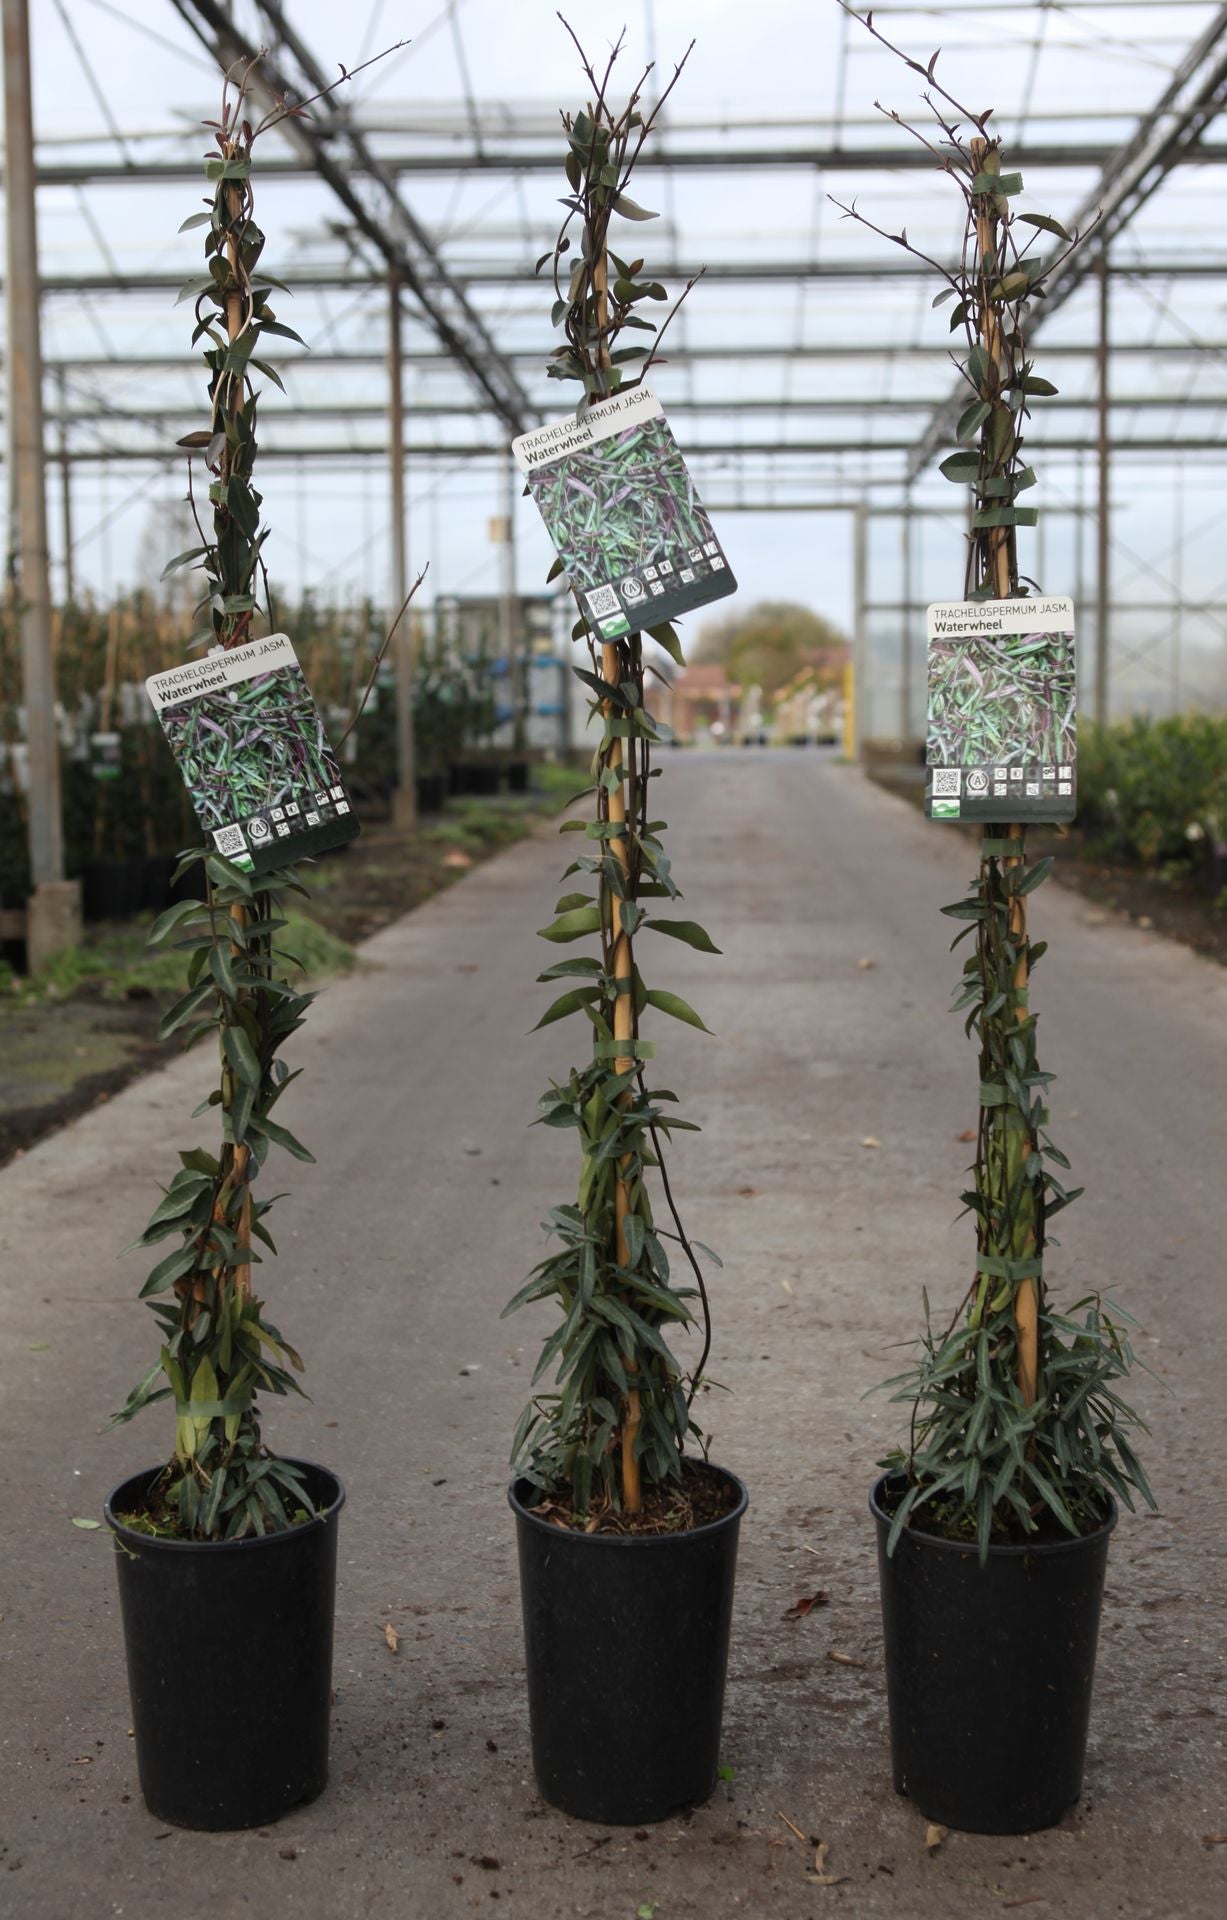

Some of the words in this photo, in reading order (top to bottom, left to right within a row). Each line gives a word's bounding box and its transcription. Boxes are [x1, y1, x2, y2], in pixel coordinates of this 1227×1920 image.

[519, 402, 621, 452] TRACHELOSPERMUM
[624, 390, 653, 408] JASM.
[524, 428, 595, 465] Waterwheel
[934, 619, 1003, 632] Waterwheel
[935, 605, 1037, 619] TRACHELOSPERMUM
[1039, 603, 1070, 614] JASM.
[153, 649, 256, 690] TRACHELOSPERMUM
[258, 639, 288, 656] JASM.
[157, 671, 228, 703] Waterwheel
